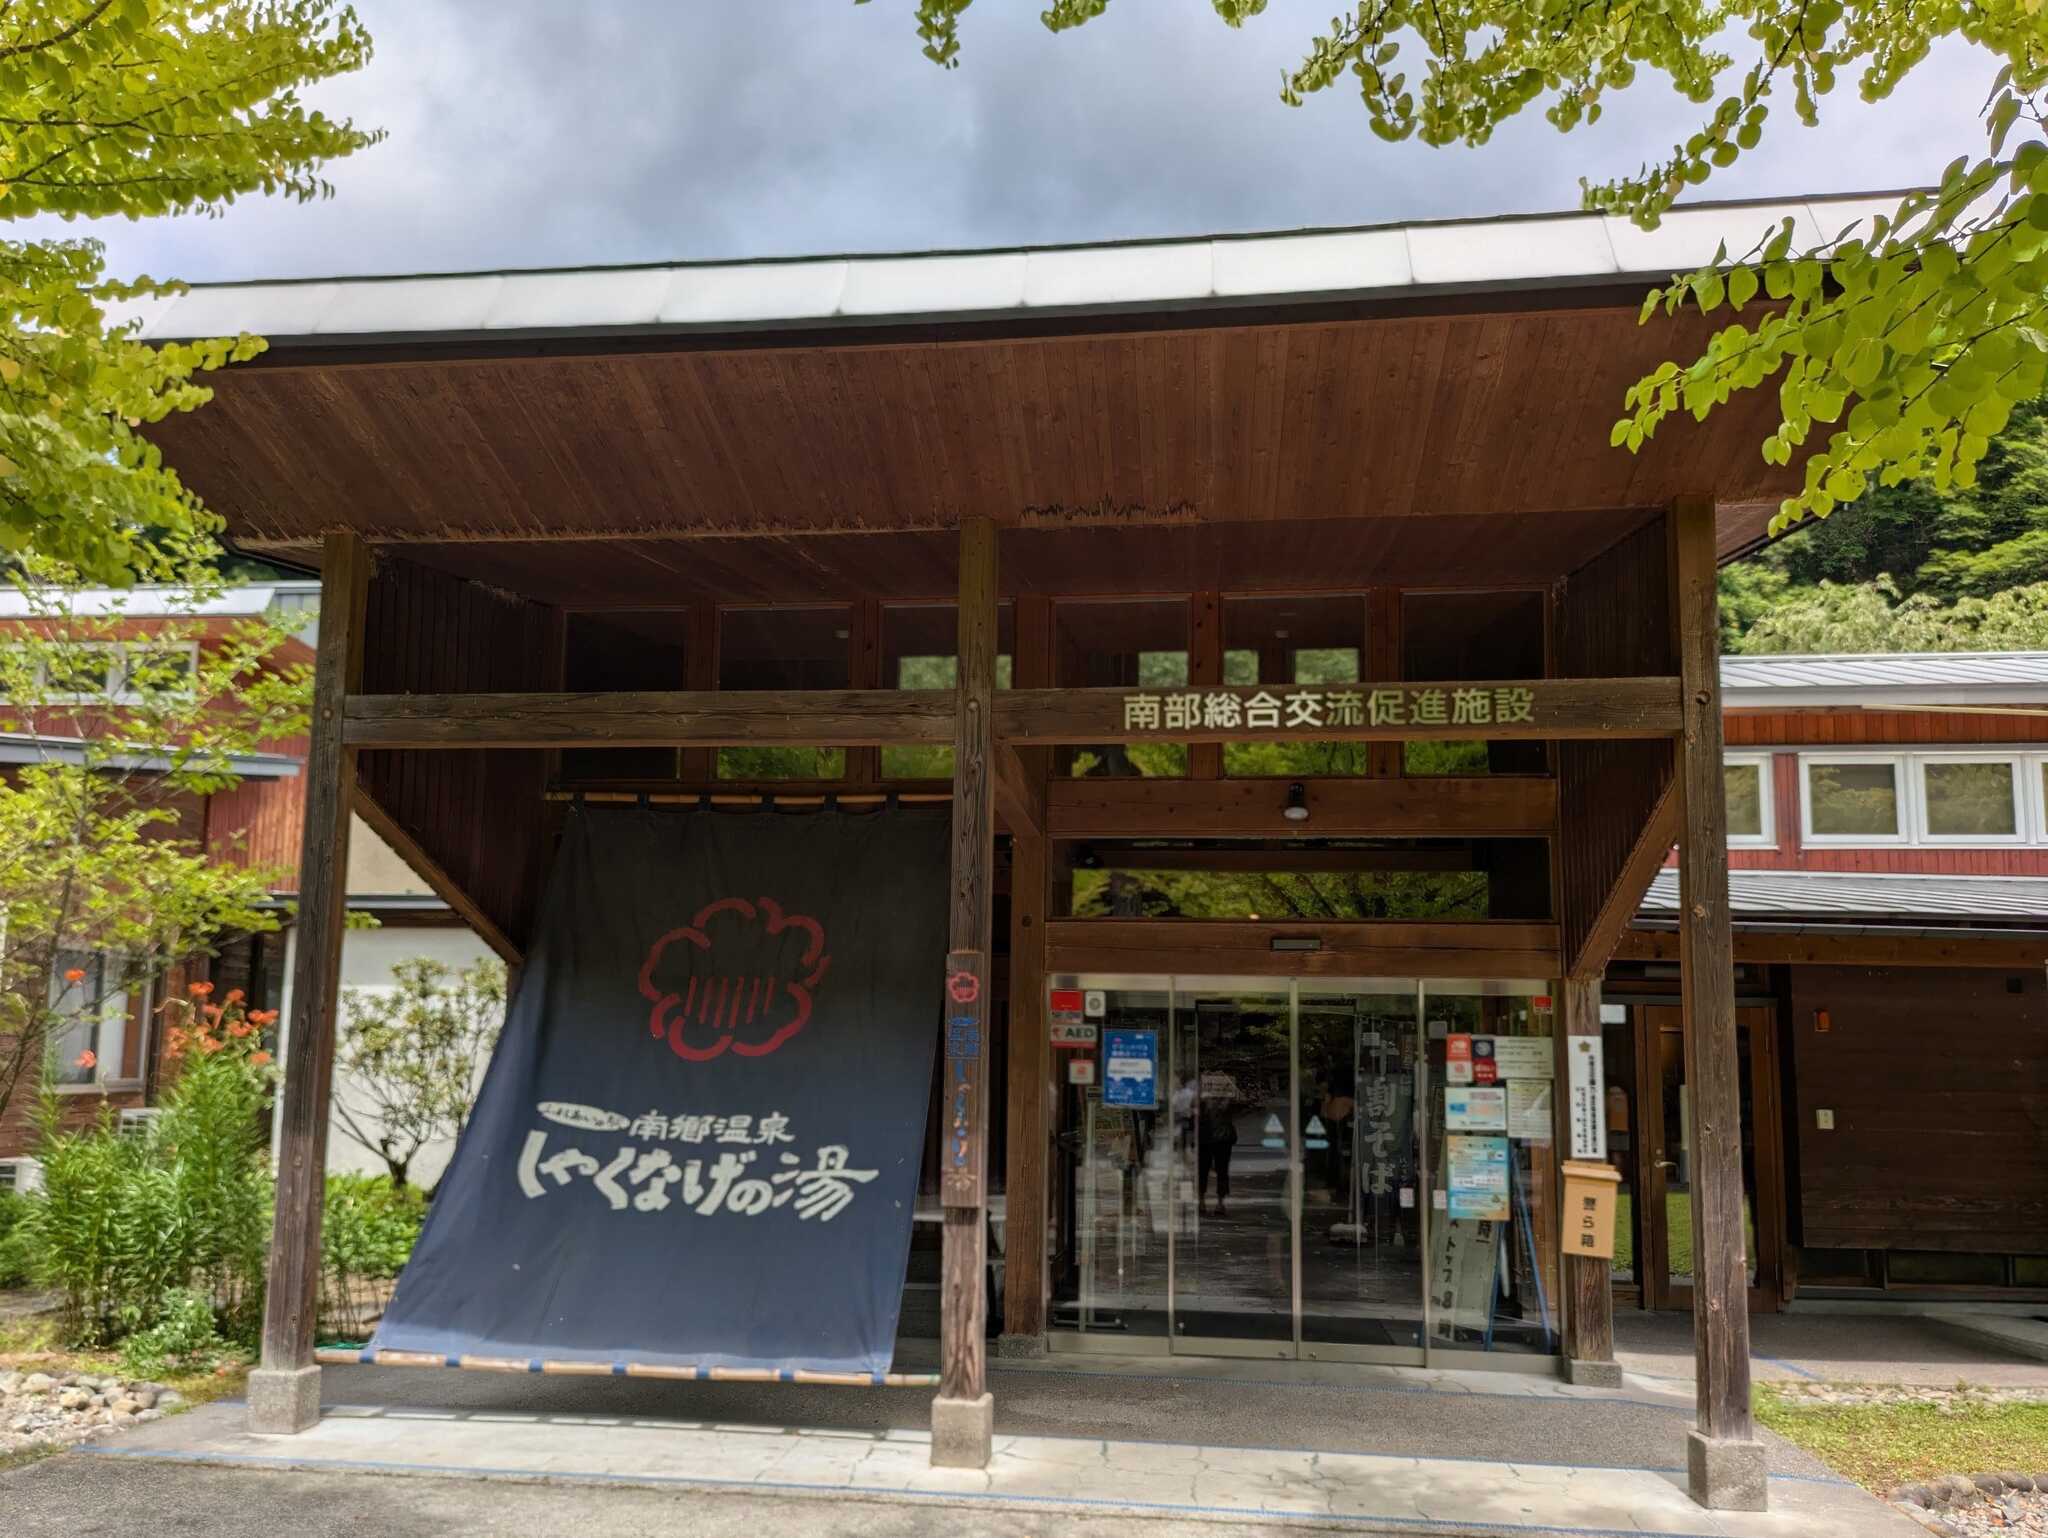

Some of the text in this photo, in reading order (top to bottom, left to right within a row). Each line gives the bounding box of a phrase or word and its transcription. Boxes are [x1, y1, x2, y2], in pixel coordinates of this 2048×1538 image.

[1123, 688, 1536, 731] 南部総合交流促進施設
[1065, 1027, 1095, 1038] AED
[628, 1109, 796, 1145] 南郷温泉
[517, 1129, 880, 1221] しゃくなげの湯
